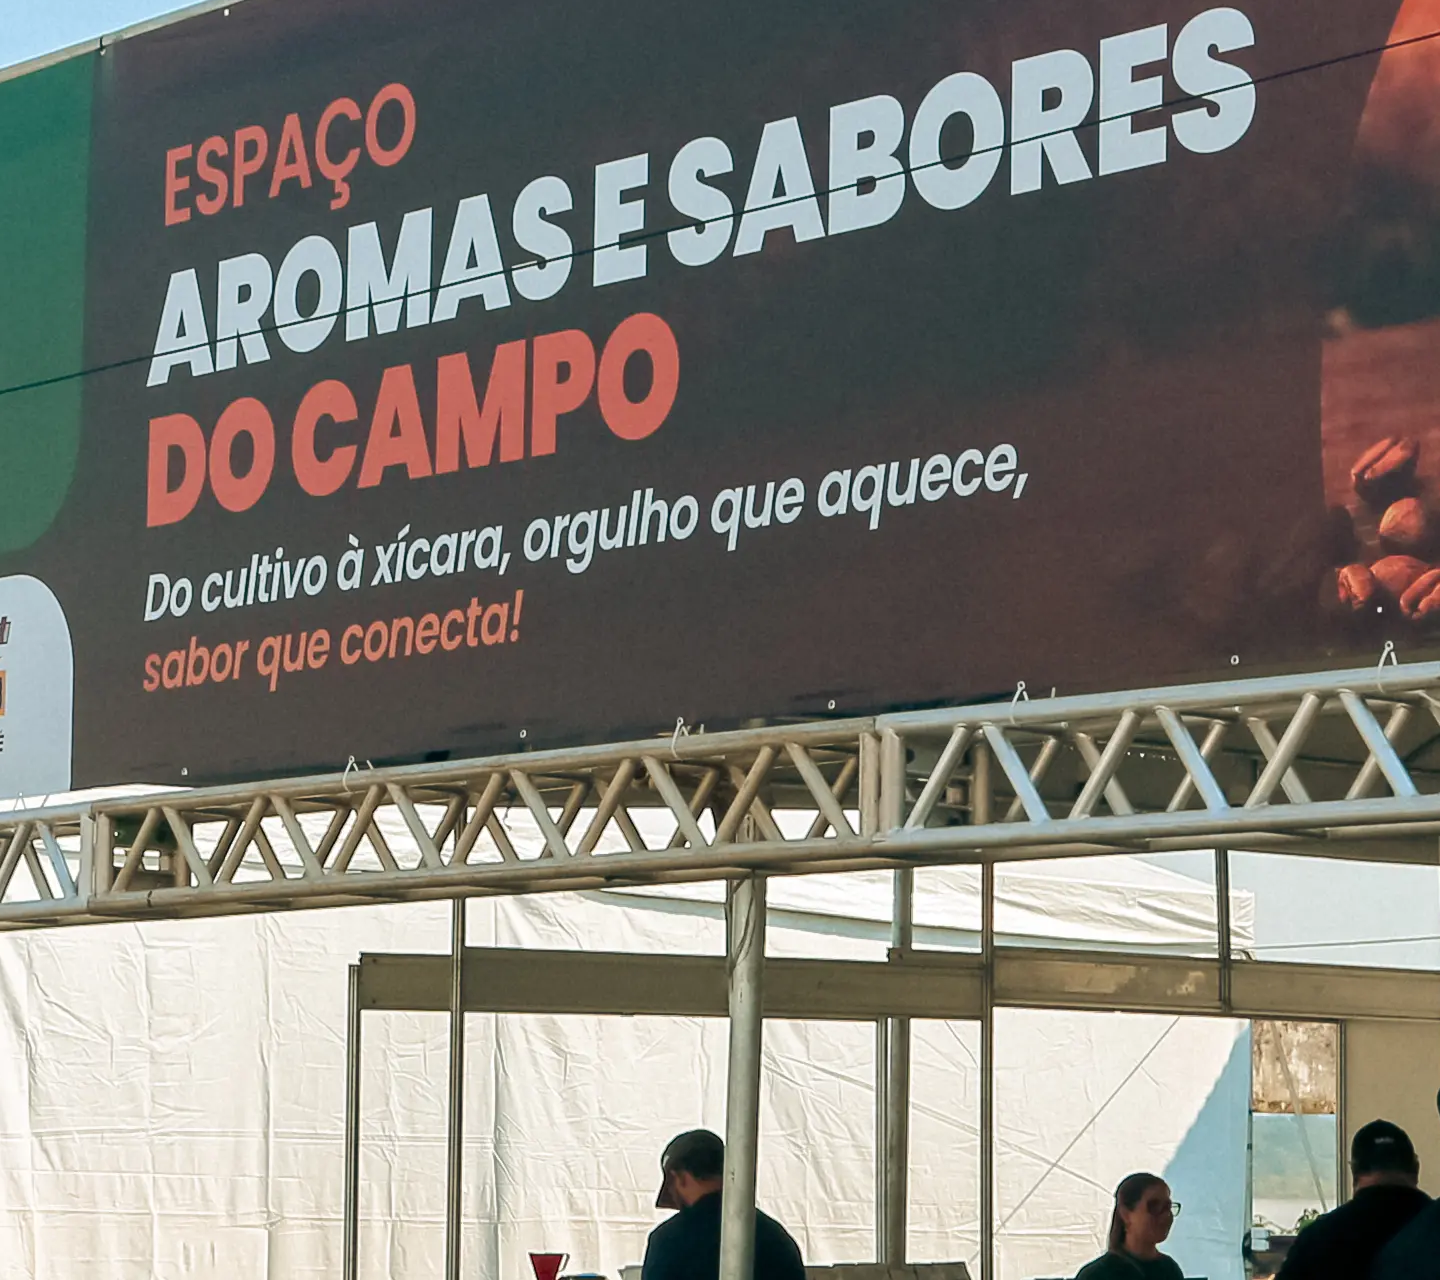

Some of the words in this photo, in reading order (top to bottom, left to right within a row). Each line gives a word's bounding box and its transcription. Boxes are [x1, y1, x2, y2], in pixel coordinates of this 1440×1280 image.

[146, 175, 573, 387] AROMAS
[592, 153, 649, 287] E
[667, 7, 1256, 266] SABORES
[164, 83, 416, 226] ESPAÇO
[146, 397, 276, 528] DO
[291, 312, 680, 497] CAMPO
[143, 572, 193, 622] Do
[201, 546, 327, 613] cultivo
[336, 533, 364, 591] à
[370, 523, 512, 587] xícara,
[522, 487, 698, 574] orgulho
[710, 477, 805, 551] que
[817, 443, 1029, 530] aquece,
[143, 636, 249, 693] sabor
[256, 616, 330, 693] que
[340, 588, 525, 665] conecta!
